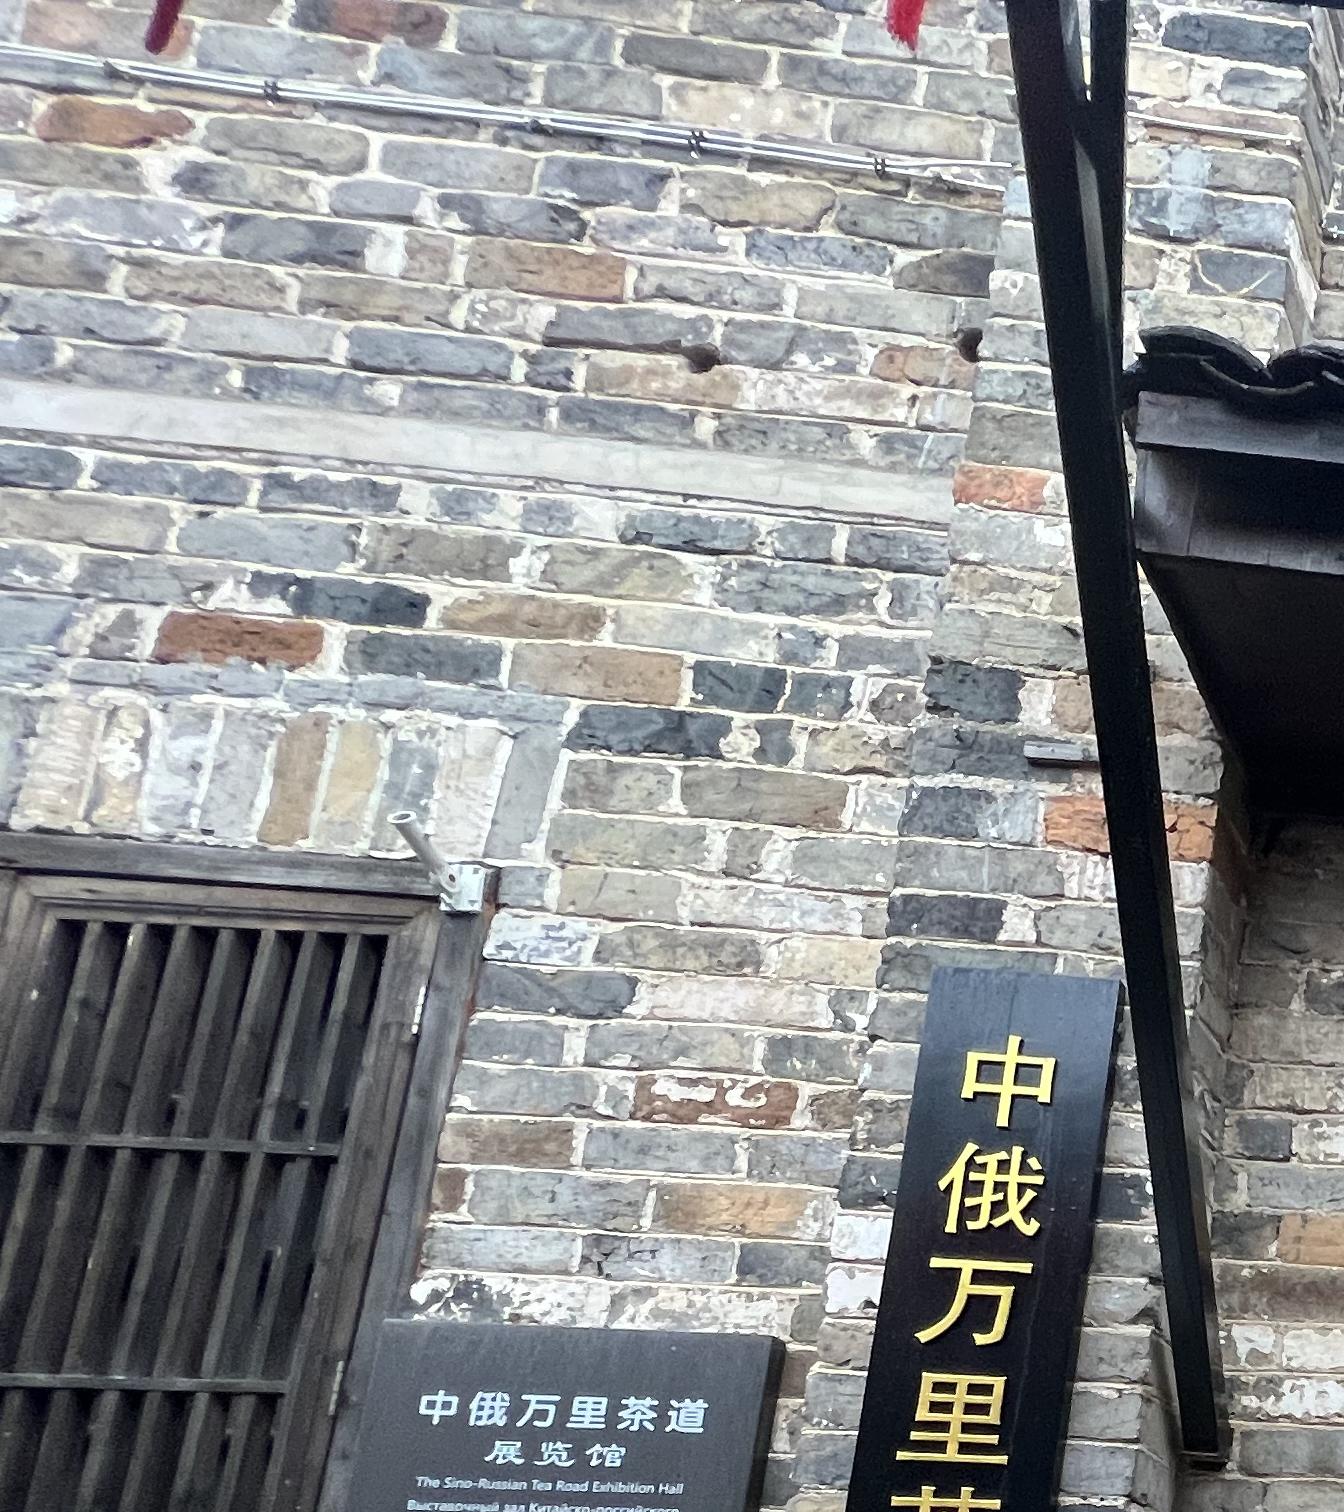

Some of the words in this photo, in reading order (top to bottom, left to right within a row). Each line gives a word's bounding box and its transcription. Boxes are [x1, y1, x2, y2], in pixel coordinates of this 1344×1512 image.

[418, 1390, 709, 1434] 中俄万里茶道
[484, 1440, 627, 1467] 展览馆
[415, 1476, 440, 1488] The
[444, 1477, 527, 1491] Sino-Russian
[532, 1480, 552, 1492] Tea
[557, 1480, 588, 1492] Road
[593, 1481, 655, 1494] Exhibition
[659, 1483, 684, 1495] Hall
